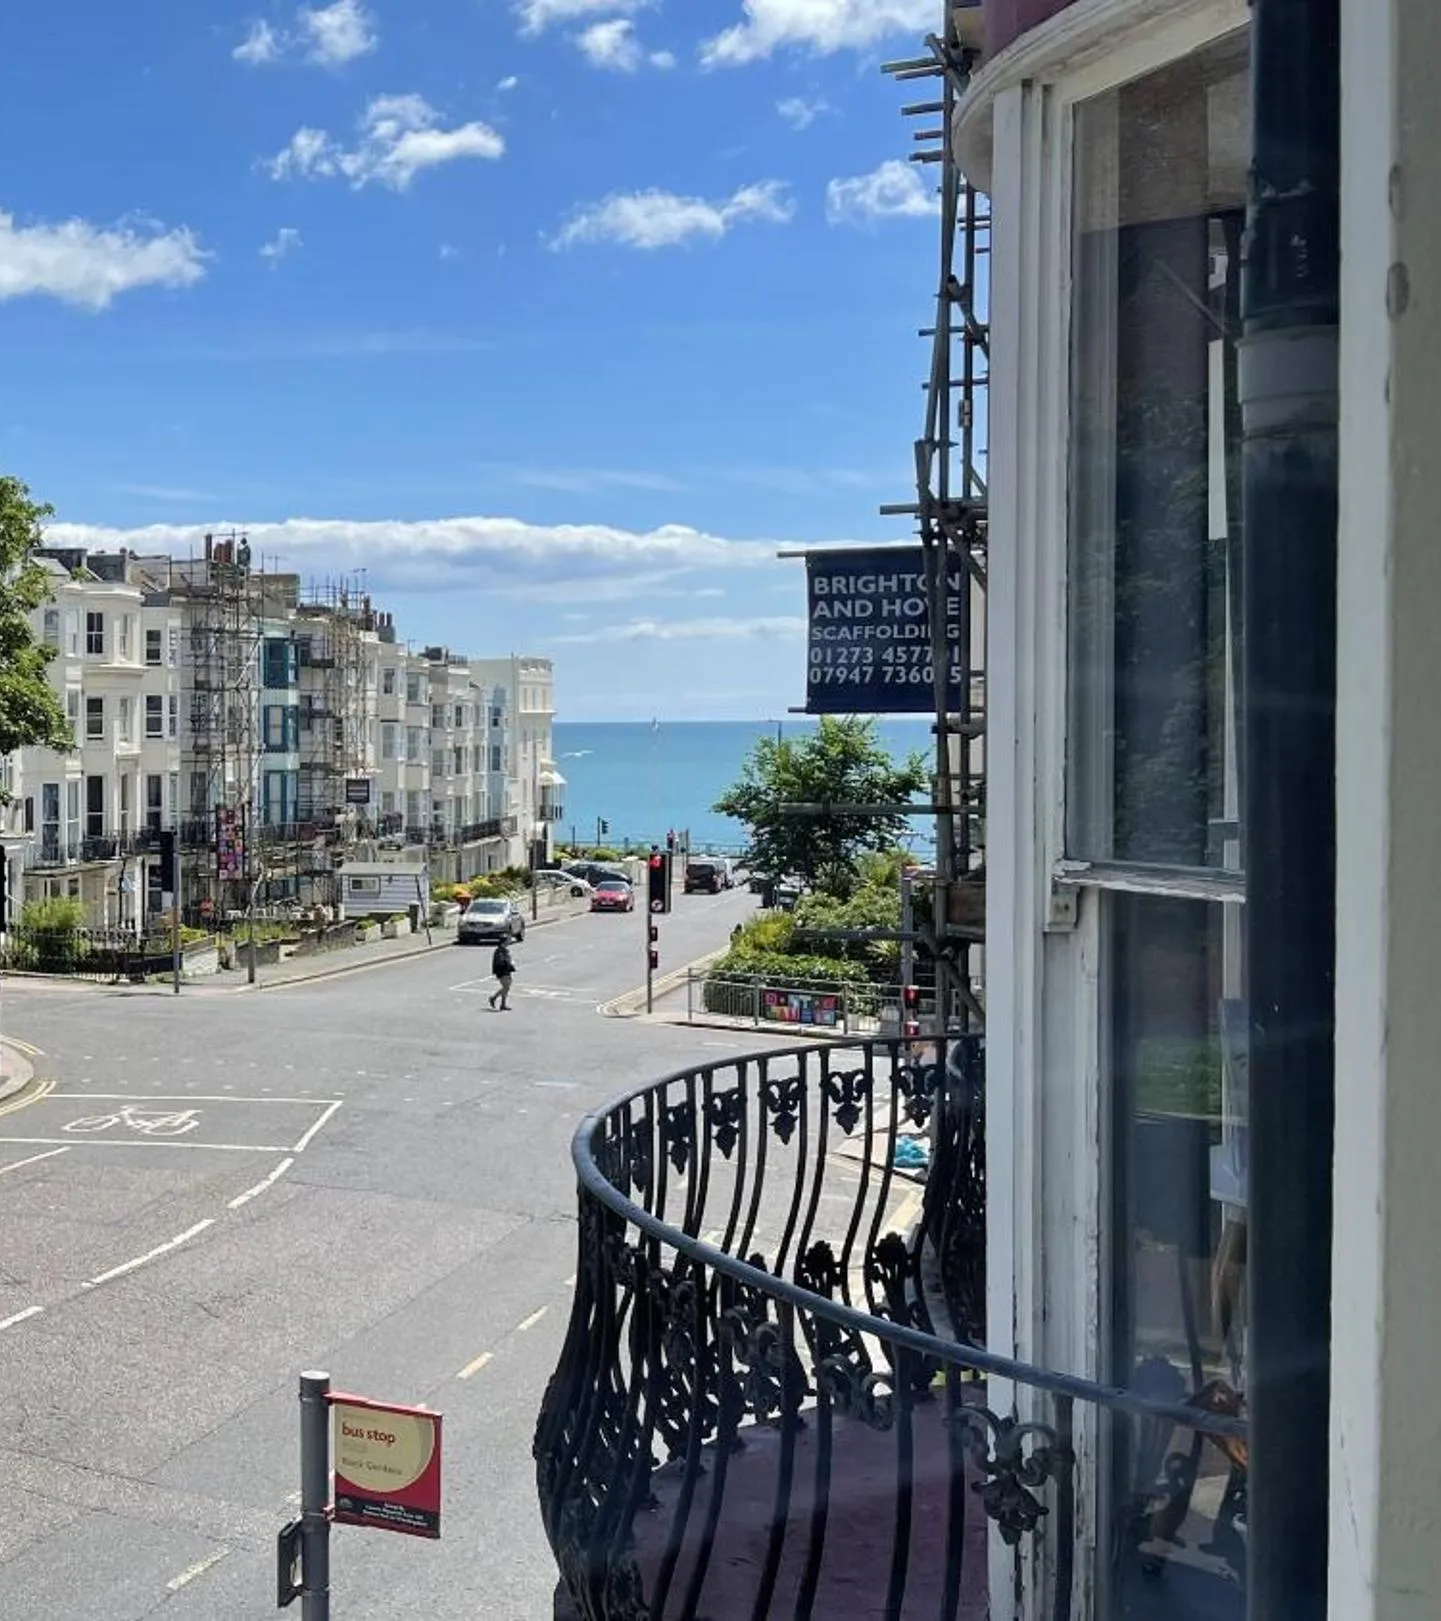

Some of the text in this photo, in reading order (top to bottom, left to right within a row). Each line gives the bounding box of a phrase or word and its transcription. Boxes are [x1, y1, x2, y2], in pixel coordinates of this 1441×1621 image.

[814, 572, 961, 595] BRIGHTON
[813, 597, 961, 619] AND HOE
[812, 623, 961, 640] SCAFFOLDIG
[810, 645, 961, 664] 01273 45771
[810, 666, 962, 684] 07947 73605
[342, 1421, 364, 1438] bus
[367, 1429, 395, 1448] stop
